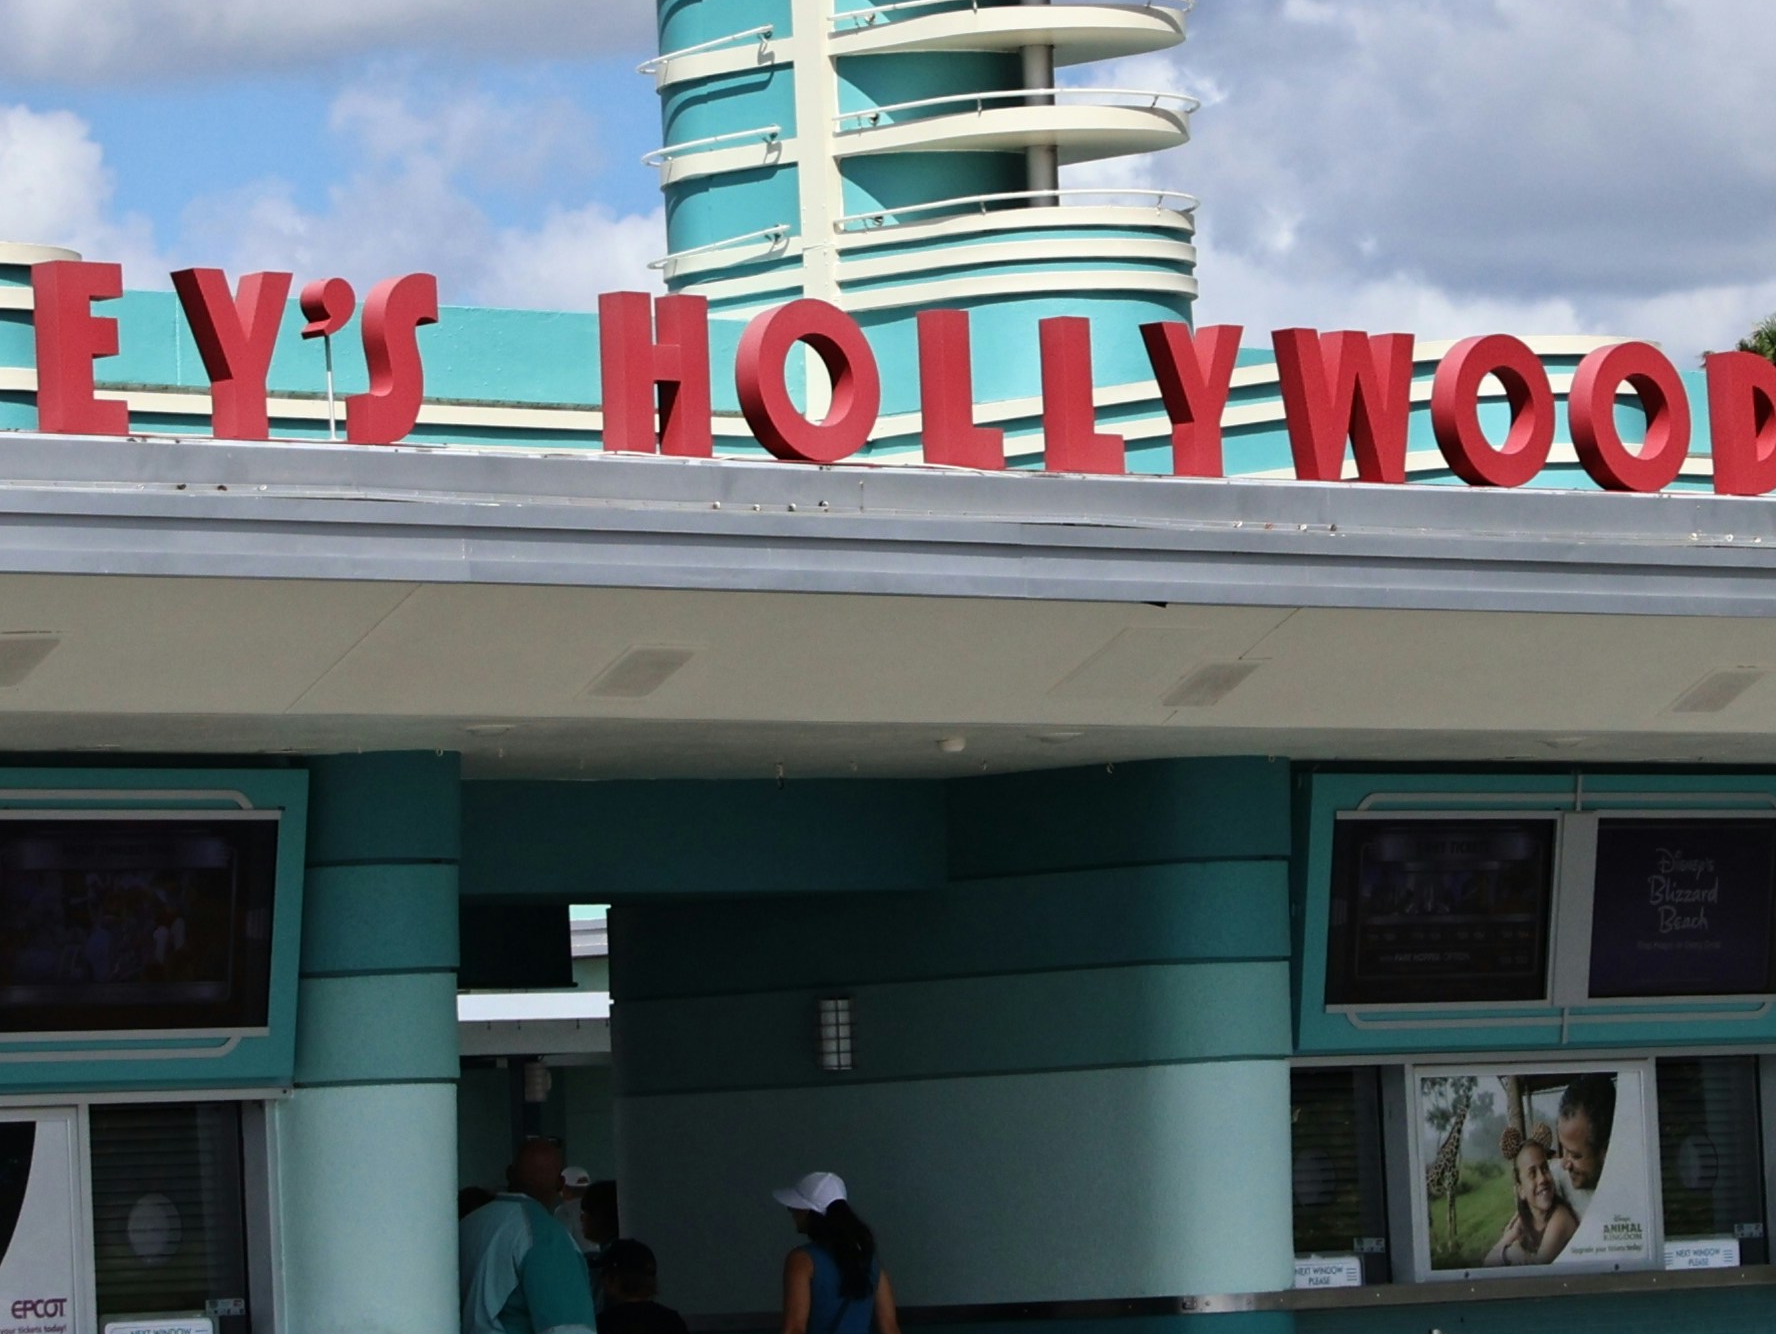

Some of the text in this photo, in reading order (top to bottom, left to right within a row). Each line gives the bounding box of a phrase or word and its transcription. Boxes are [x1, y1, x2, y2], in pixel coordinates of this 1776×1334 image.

[1655, 847, 1715, 880] Disney's
[1647, 875, 1719, 906] Blizzard
[1657, 904, 1709, 934] Beach
[1603, 1222, 1642, 1233] ANIMAL
[1313, 1266, 1343, 1275] WINDOW
[1308, 1276, 1330, 1285] PLEASE
[11, 1298, 67, 1319] EPCOT
[18, 1325, 42, 1334] tickets
[43, 1324, 67, 1334] today!
